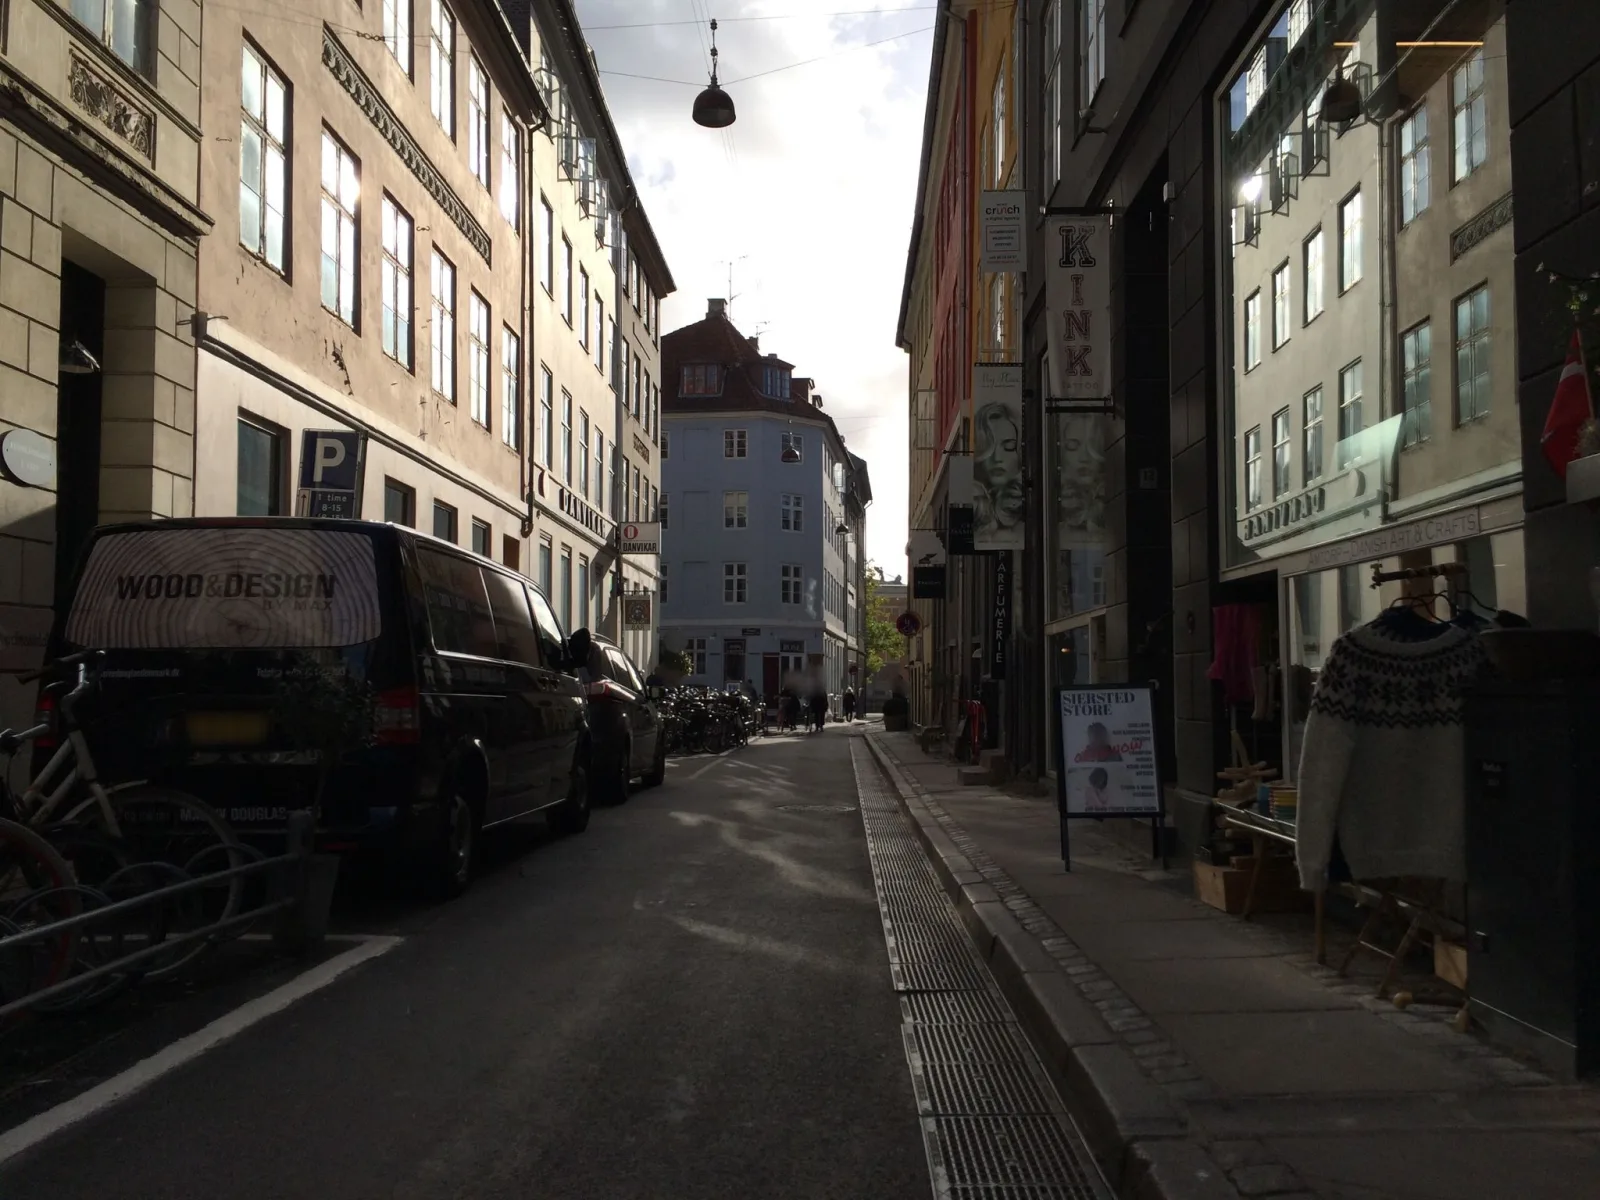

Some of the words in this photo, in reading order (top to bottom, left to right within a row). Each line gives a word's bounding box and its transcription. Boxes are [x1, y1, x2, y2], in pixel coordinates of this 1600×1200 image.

[985, 204, 1020, 215] crunch
[1059, 226, 1096, 376] KINK
[313, 438, 346, 482] P
[327, 493, 347, 502] time
[321, 503, 342, 512] 8-15
[1390, 529, 1412, 548] ART
[1414, 524, 1422, 543] &
[1425, 513, 1476, 540] CRAFTS
[623, 542, 657, 552] DANVIKAR
[117, 573, 337, 600] WOOD&DESIGN
[263, 601, 285, 611] BY
[293, 601, 333, 611] MAX
[995, 550, 1006, 663] PARFUMERIE
[1062, 692, 1135, 705] SIERSTED
[1063, 704, 1113, 716] STORE
